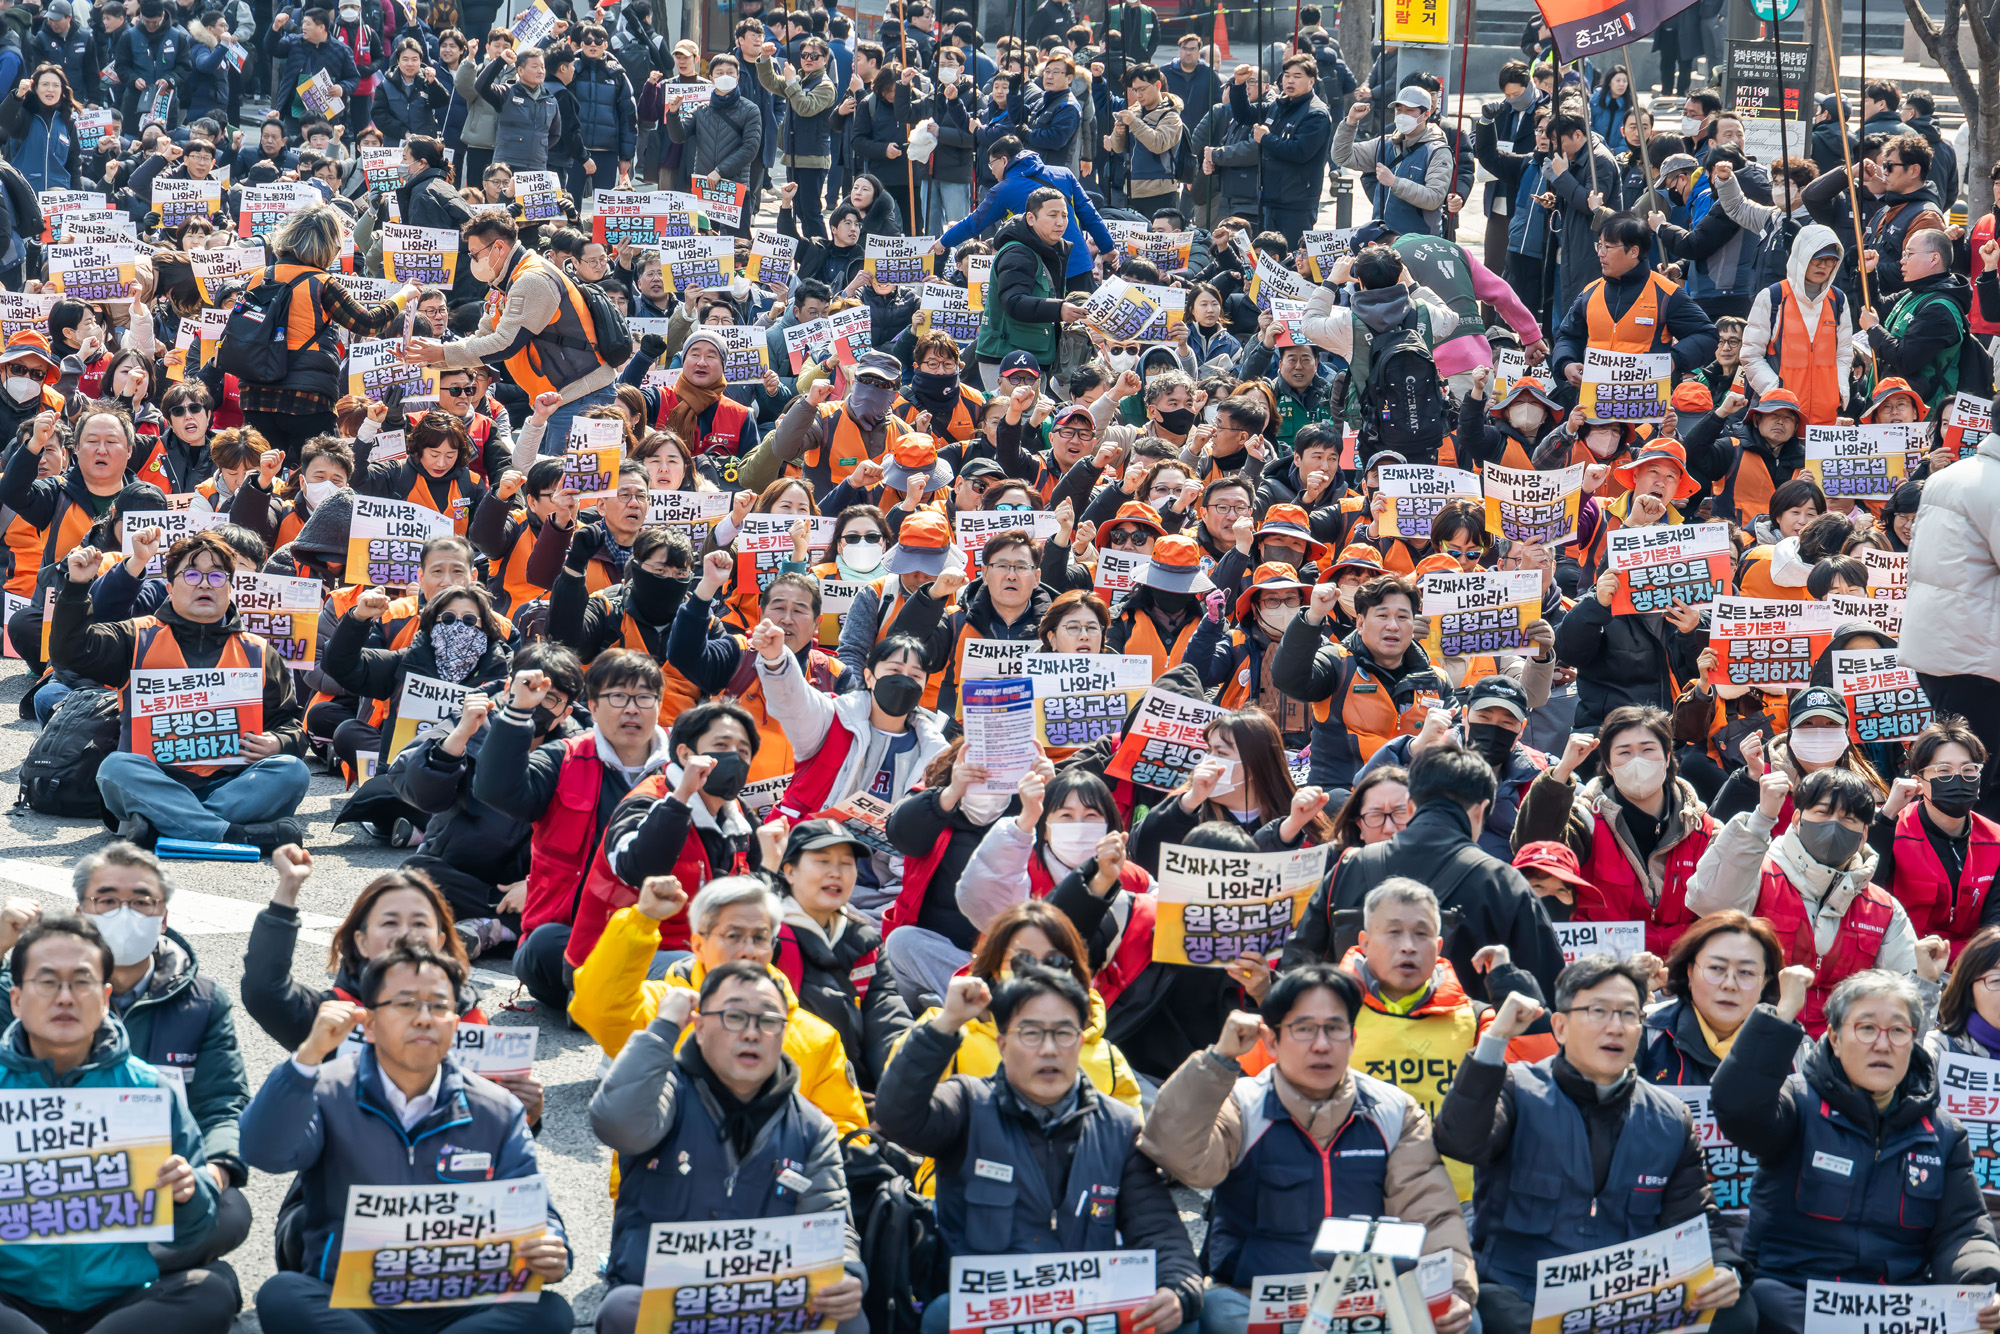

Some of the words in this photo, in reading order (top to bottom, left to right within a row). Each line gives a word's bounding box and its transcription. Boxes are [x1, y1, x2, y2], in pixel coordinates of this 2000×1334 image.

[681, 85, 706, 94] 노동자의
[1736, 97, 1763, 107] M7154
[154, 181, 190, 191] 진짜사장
[516, 173, 544, 184] 진짜사장
[41, 194, 58, 205] 모든
[59, 192, 89, 204] 노동자의
[172, 190, 202, 200] 나와라!
[244, 191, 262, 200] 모든
[263, 191, 295, 201] 노동자의
[597, 194, 615, 205] 모든
[617, 194, 651, 205] 노동자의
[43, 203, 82, 215] 노동기본권
[162, 201, 209, 214] 원청교섭
[246, 202, 286, 211] 노동기본권
[599, 206, 641, 215] 노동기본권
[81, 211, 113, 222] 노동자의
[605, 216, 655, 231] 투쟁으로
[68, 223, 106, 234] 진짜사장
[383, 227, 423, 240] 진짜사장
[1130, 230, 1163, 242] 진짜사장
[402, 238, 437, 250] 나와라!
[661, 238, 697, 250] 진짜사장
[757, 232, 790, 247] 진짜사장
[868, 238, 905, 250] 진짜사장
[1145, 239, 1175, 251] 나와라!
[1305, 233, 1334, 244] 진짜사장
[1320, 238, 1350, 253] 나와라!
[51, 246, 93, 259] 진짜사장
[190, 252, 225, 264] 진짜사장
[393, 252, 443, 269] 원청교섭
[678, 247, 713, 260] 나와라!
[885, 247, 918, 259] 나와라!
[1137, 249, 1180, 262] 원청교섭
[1414, 242, 1460, 262] 민주노총
[73, 254, 111, 269] 나와라!
[207, 260, 243, 275] 나와라!
[670, 259, 720, 278] 원청교섭
[875, 258, 924, 273] 원청교섭
[1259, 253, 1291, 281] 진짜사장
[62, 268, 120, 286] 원청교섭
[394, 267, 450, 284] 쟁취하자!
[673, 274, 729, 292] 쟁취하자!
[875, 269, 930, 285] 쟁취하자!
[64, 283, 130, 301] 쟁취하자!
[925, 285, 964, 299] 진짜사장
[1268, 274, 1301, 297] 나와라!
[353, 289, 387, 301] 나와라!
[7, 305, 41, 319] 나와라!
[1274, 301, 1294, 311] 모든
[833, 315, 852, 328] 모든
[931, 310, 981, 327] 원청교섭
[788, 328, 806, 341] 모든
[1588, 351, 1637, 369] 진짜사장
[363, 363, 422, 388] 원청교섭
[1611, 367, 1653, 382] 나와라!
[1596, 382, 1659, 401] 원청교섭
[1595, 400, 1667, 419] 쟁취하자!
[1957, 398, 1982, 416] 모든
[1809, 428, 1858, 443] 진짜사장
[1834, 441, 1878, 456] 나와라!
[1382, 468, 1435, 482] 진짜사장
[1832, 458, 1886, 477] 원청교섭
[1486, 466, 1542, 488] 진짜사장
[1409, 480, 1456, 495] 나와라!
[1512, 485, 1561, 504] 나와라!
[1832, 477, 1897, 498] 쟁취하자!
[356, 500, 417, 521] 진짜사장
[655, 506, 702, 523] 나와라!
[1500, 500, 1566, 527] 원청교섭
[386, 521, 431, 541] 나와라!
[742, 520, 770, 535] 모든
[960, 518, 986, 533] 모든
[987, 513, 1036, 530] 노동자의
[1611, 535, 1642, 553] 모든
[1643, 527, 1696, 549] 노동자의
[1102, 555, 1131, 573] 모든
[1616, 545, 1682, 569] 노동기본권
[1627, 559, 1710, 588] 투쟁으로
[1427, 576, 1487, 595] 진짜사장
[1457, 587, 1510, 609] 나와라!
[1630, 579, 1725, 613] 쟁취하자!
[1716, 603, 1747, 620] 모든
[1749, 603, 1803, 619] 노동자의
[1832, 598, 1889, 617] 진짜사장
[1440, 607, 1519, 634] 원청교섭
[1719, 620, 1787, 637] 노동기본권
[1440, 630, 1531, 658] 쟁취하자!
[1728, 636, 1811, 660] 투쟁으로
[1027, 658, 1091, 675] 진짜사장
[1837, 658, 1868, 674] 모든
[136, 677, 166, 695] 모든
[167, 671, 226, 692] 노동자의
[1060, 671, 1117, 693] 나와라!
[1842, 670, 1910, 694] 노동기본권
[140, 691, 209, 714] 노동기본권
[1042, 693, 1127, 721] 원청교섭
[1145, 695, 1177, 716] 모든
[1855, 686, 1933, 717] 투쟁으로
[151, 707, 239, 738] 투쟁으로
[1165, 850, 1250, 878] 진짜사장
[1208, 874, 1282, 901] 나와라!
[1183, 896, 1294, 935] 원청교섭
[1943, 1063, 1989, 1092] 모든
[16, 1116, 109, 1153] 나와라!
[1916, 1154, 1941, 1166] 민주노총
[355, 1191, 458, 1219] 진짜사장
[405, 1208, 496, 1242] 나와라!
[655, 1226, 757, 1256] 진짜사장
[373, 1240, 512, 1279] 원청교섭
[704, 1243, 793, 1279] 나와라!
[1543, 1247, 1635, 1288] 진짜사장
[958, 1267, 1008, 1294] 모든
[1012, 1256, 1102, 1291] 노동자의
[1590, 1257, 1671, 1301] 나와라!
[369, 1268, 532, 1307] 쟁취하자!
[673, 1274, 808, 1318] 원청교섭
[1259, 1284, 1308, 1302] 모든
[966, 1289, 1076, 1323] 노동기본권
[1561, 1283, 1688, 1334] 원청교섭
[1812, 1288, 1913, 1317] 진짜사장
